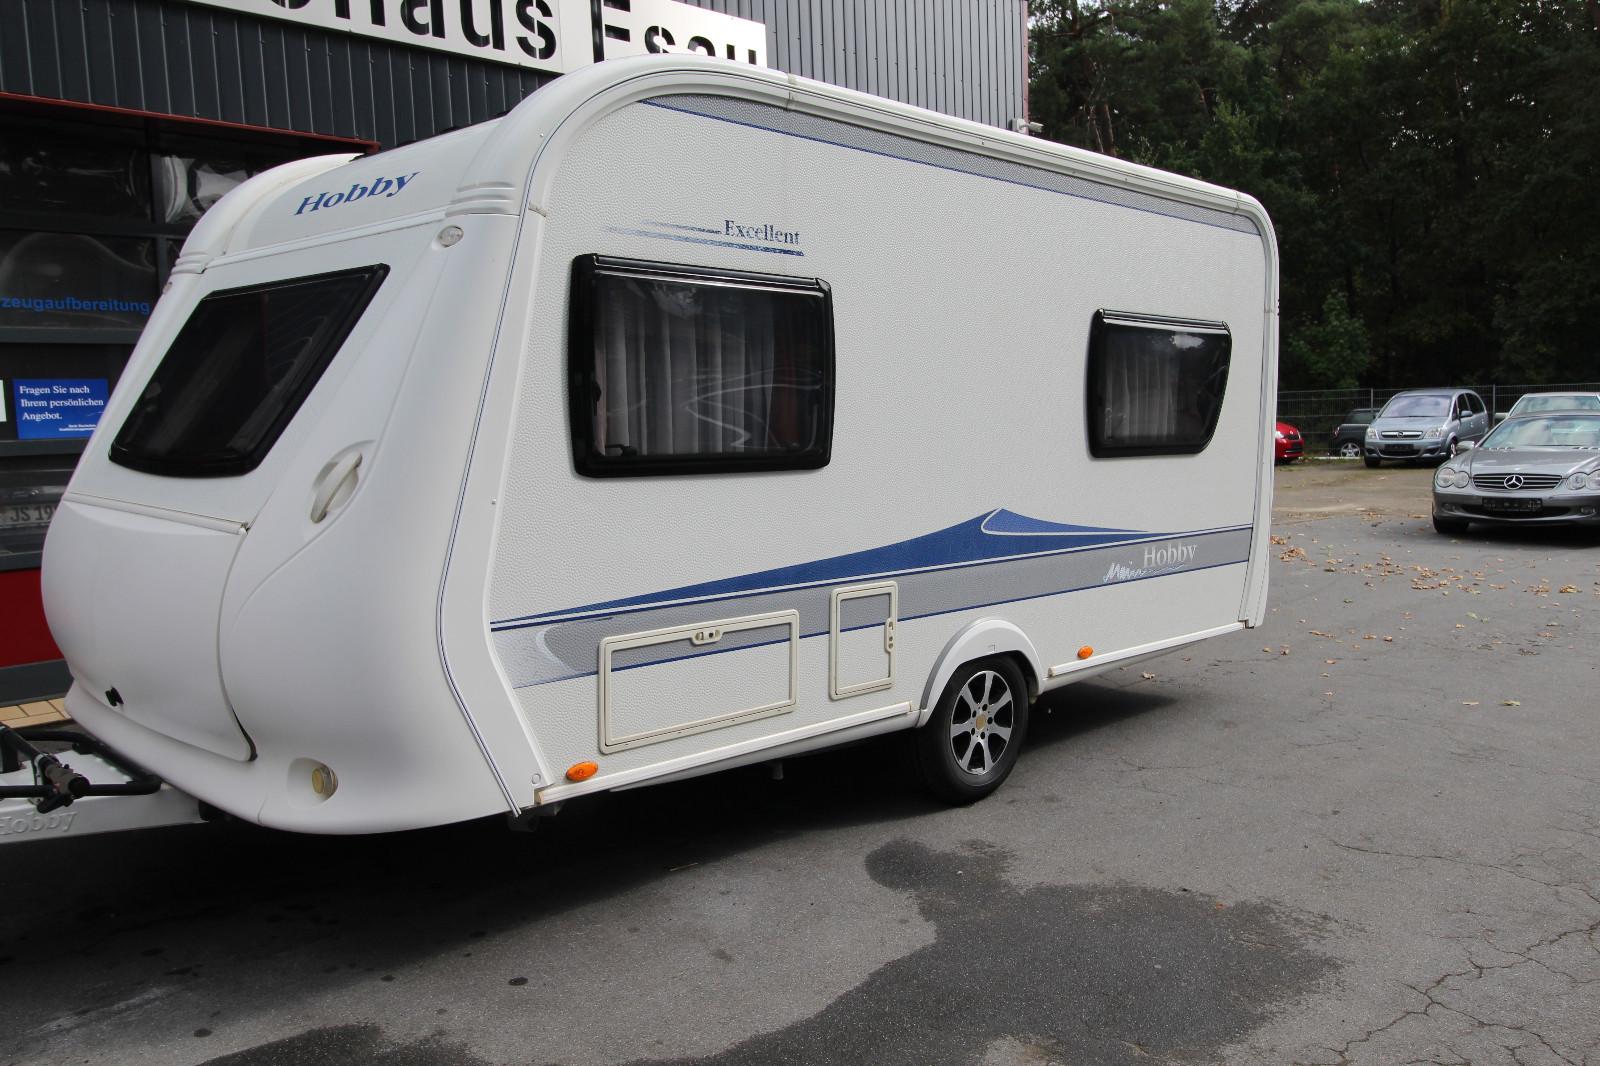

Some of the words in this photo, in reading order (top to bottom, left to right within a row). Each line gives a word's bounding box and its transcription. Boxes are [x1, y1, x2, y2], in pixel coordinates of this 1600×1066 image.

[293, 171, 420, 216] Hobby
[724, 219, 800, 245] Excellent
[19, 385, 51, 396] Fragen
[52, 385, 67, 394] Sie
[69, 385, 90, 394] nach
[20, 399, 48, 407] Ihrem
[49, 398, 104, 408] persönlichen
[22, 411, 62, 421] Angebot.
[1143, 542, 1198, 568] Hobby
